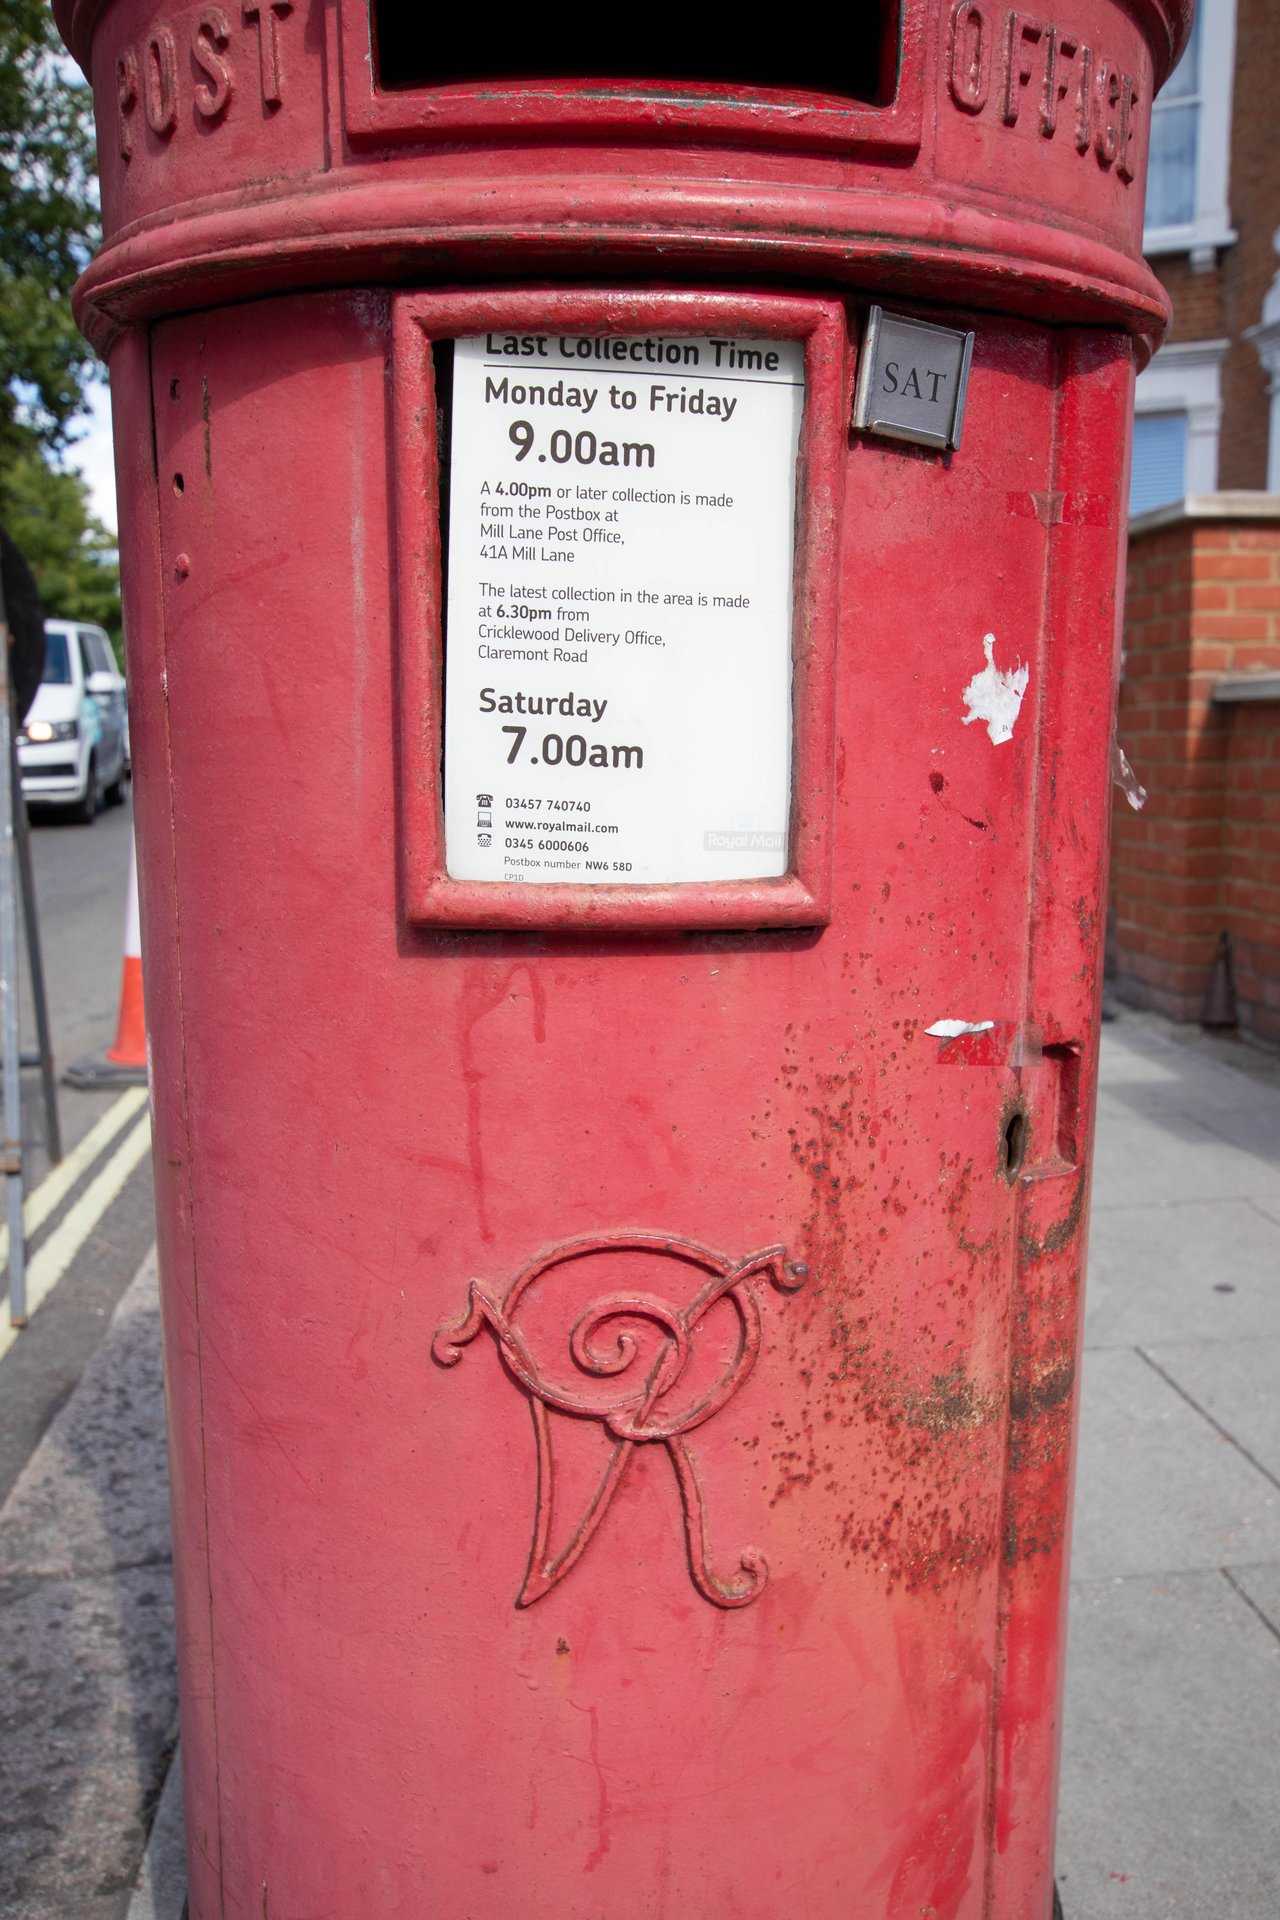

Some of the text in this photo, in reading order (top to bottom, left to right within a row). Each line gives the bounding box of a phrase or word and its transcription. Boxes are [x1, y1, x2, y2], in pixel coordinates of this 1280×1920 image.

[116, 0, 1138, 182] POST OFFICE
[486, 333, 779, 371] Last Collection Time
[883, 362, 947, 403] SAT
[486, 377, 737, 422] Monday to Friday
[509, 420, 655, 468] 9.00am
[480, 481, 734, 508] A 4.00pm or later collection is made
[480, 502, 619, 523] from the Postbox at
[480, 524, 625, 546] Mill Lane Post Office,
[479, 545, 575, 563] 41A Mill Lane
[478, 583, 750, 609] The latest collection in the area is made
[478, 604, 590, 623] at 6.30pm from
[478, 624, 666, 648] Cricklewood Delivery Office,
[478, 645, 588, 663] Claremont Road
[480, 688, 607, 723] Saturday
[502, 726, 643, 769] 7.00am
[505, 798, 591, 813] 03457 740740
[504, 821, 619, 834] www.royalmail.com
[504, 838, 590, 853] 0345 6000606
[708, 832, 781, 849] Royal Mail
[504, 856, 633, 872] Postbox number NW6 58D
